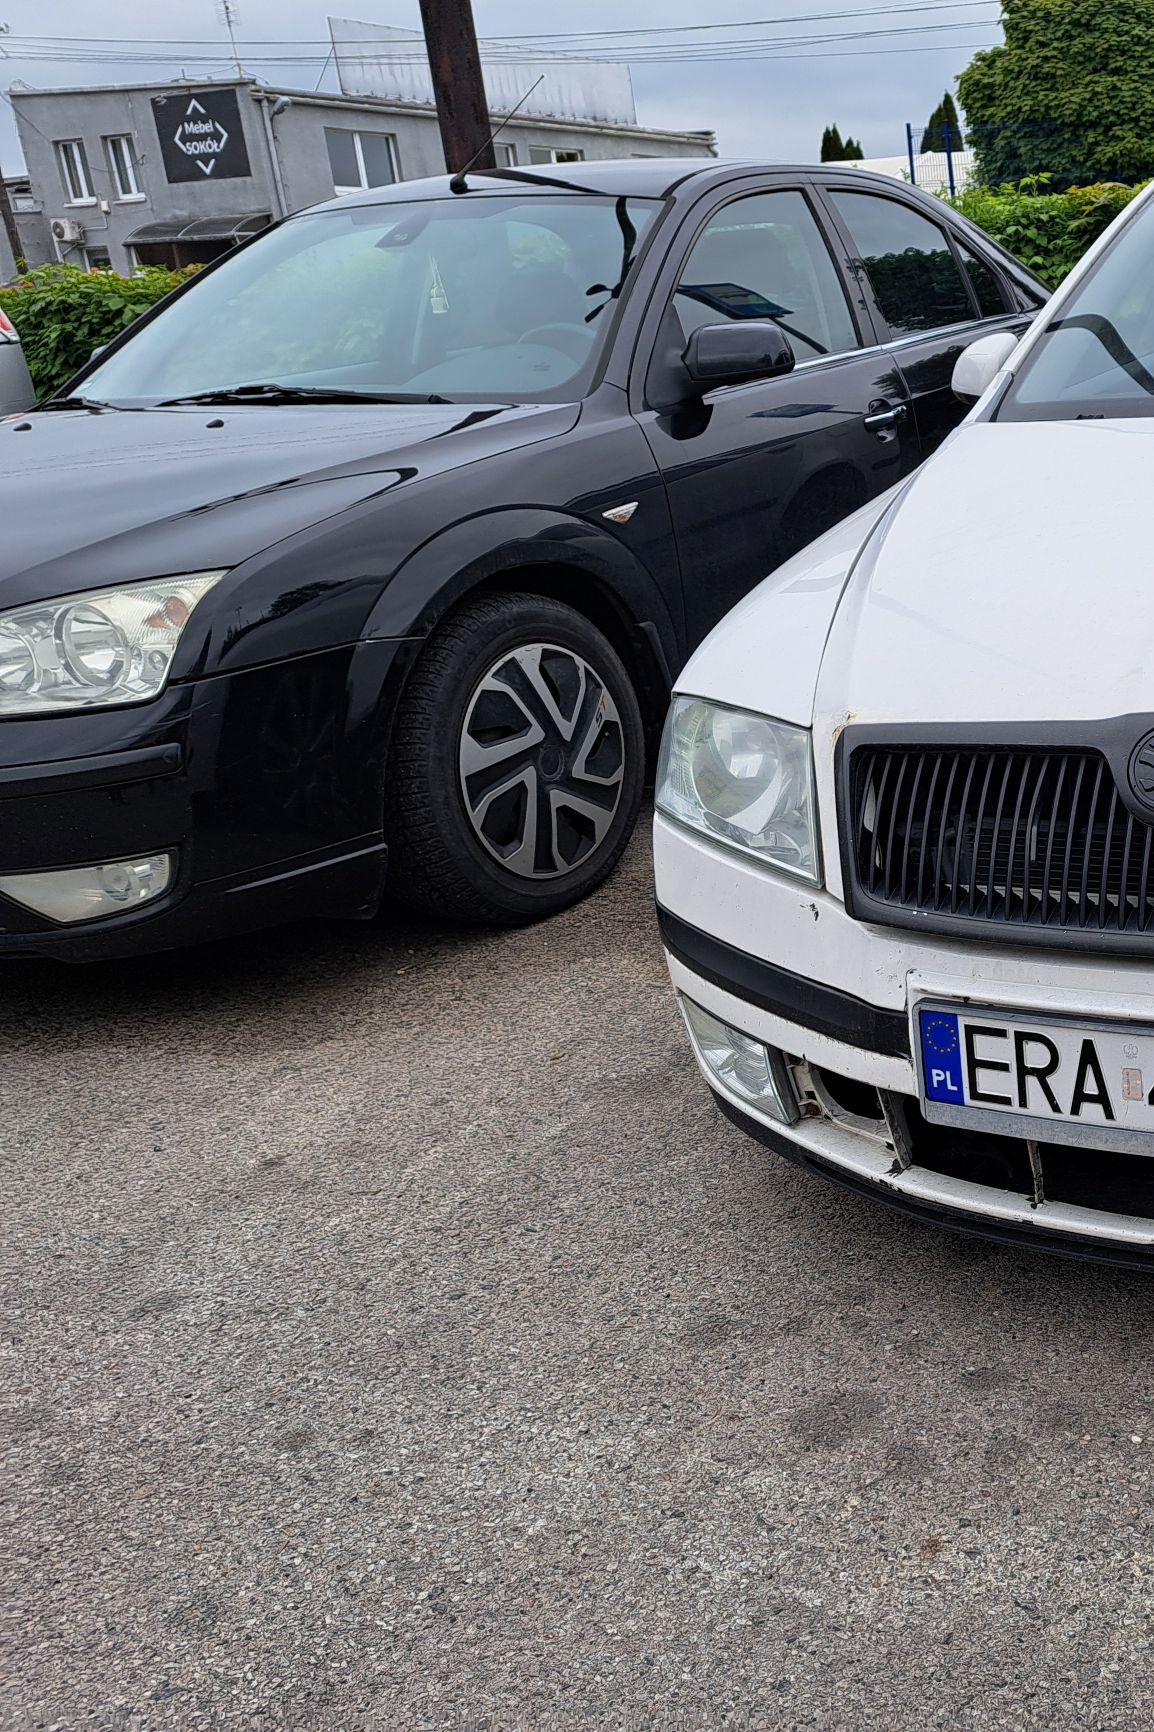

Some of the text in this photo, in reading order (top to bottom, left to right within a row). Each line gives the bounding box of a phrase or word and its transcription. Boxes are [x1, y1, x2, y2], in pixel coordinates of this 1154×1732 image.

[184, 119, 214, 135] Mebel
[186, 137, 221, 155] SOKÓŁ
[931, 1068, 958, 1091] PL
[963, 1023, 1115, 1121] ERA
